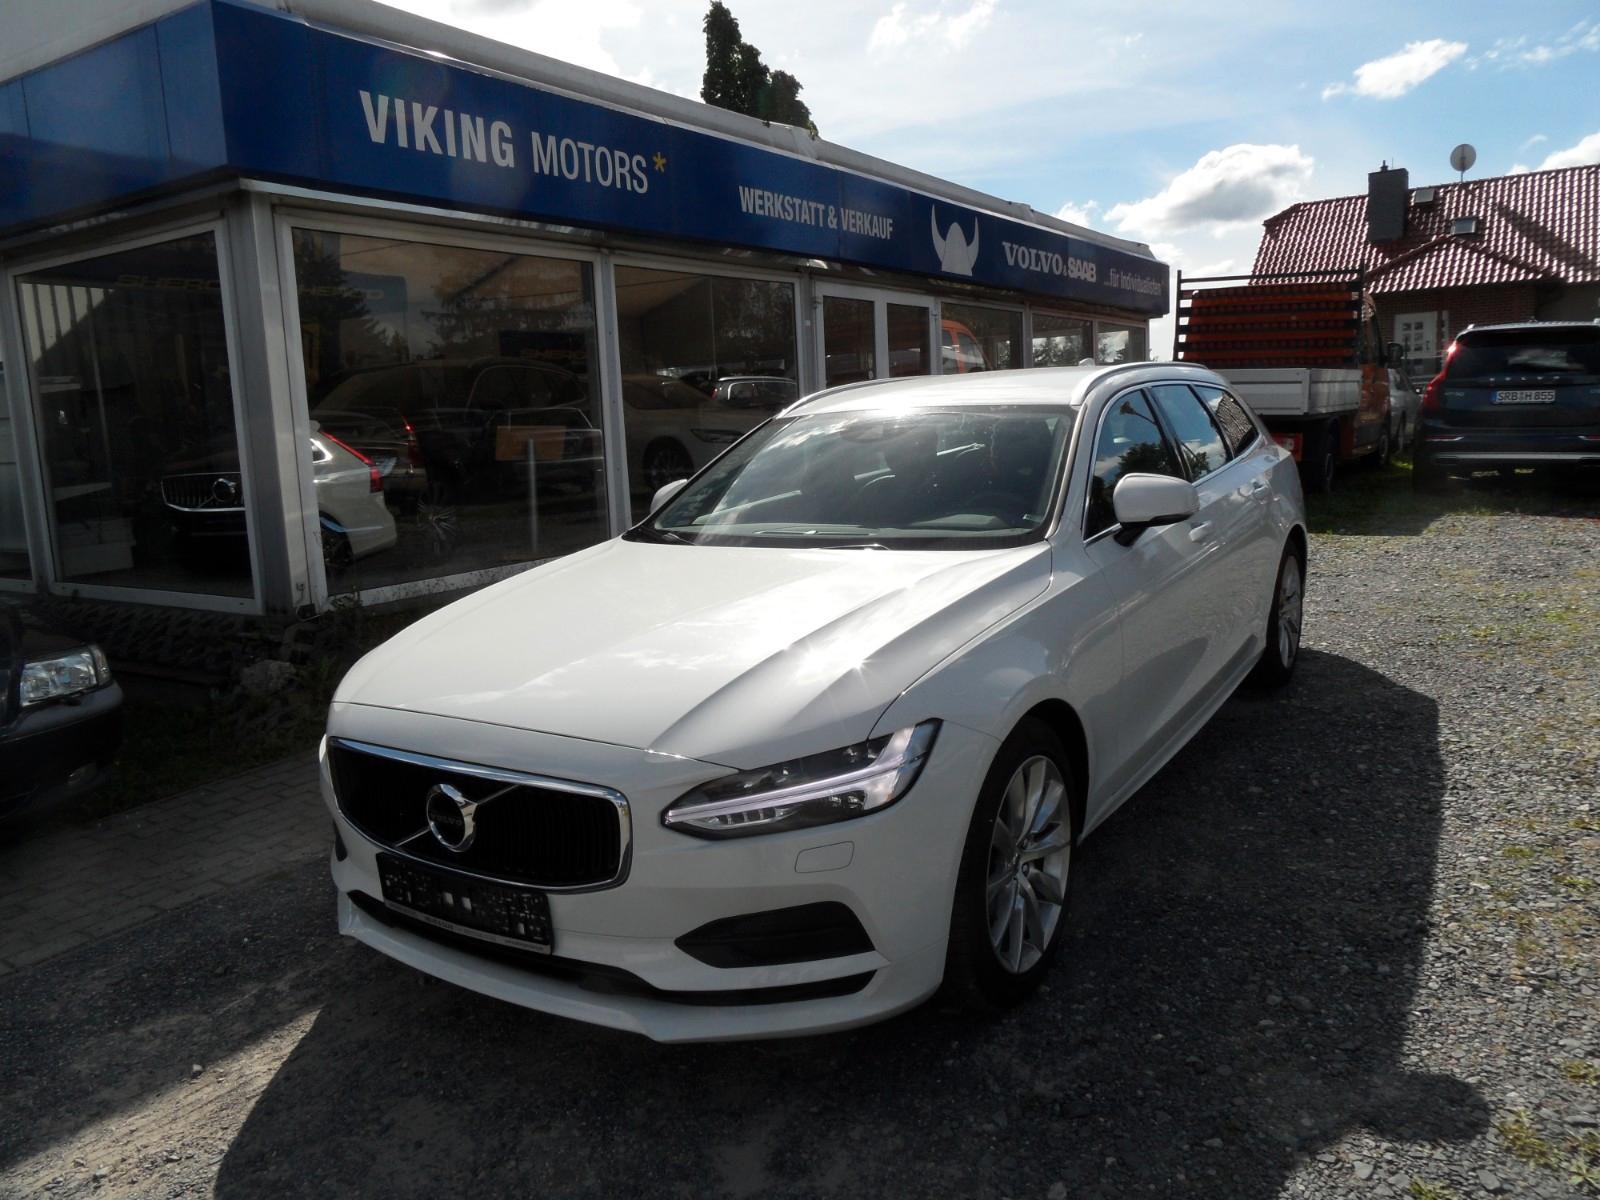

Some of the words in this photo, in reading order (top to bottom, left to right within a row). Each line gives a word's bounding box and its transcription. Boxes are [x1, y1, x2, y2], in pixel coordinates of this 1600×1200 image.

[359, 90, 515, 168] VIKING
[531, 132, 648, 194] MOTORS
[738, 185, 825, 227] WERKSTATT
[827, 205, 838, 229] &
[840, 207, 893, 240] VERKAUF
[1002, 241, 1063, 276] VOLVO
[1068, 256, 1097, 283] SAAB
[1498, 391, 1518, 401] SRB
[1525, 391, 1533, 401] H
[1535, 391, 1554, 401] 855
